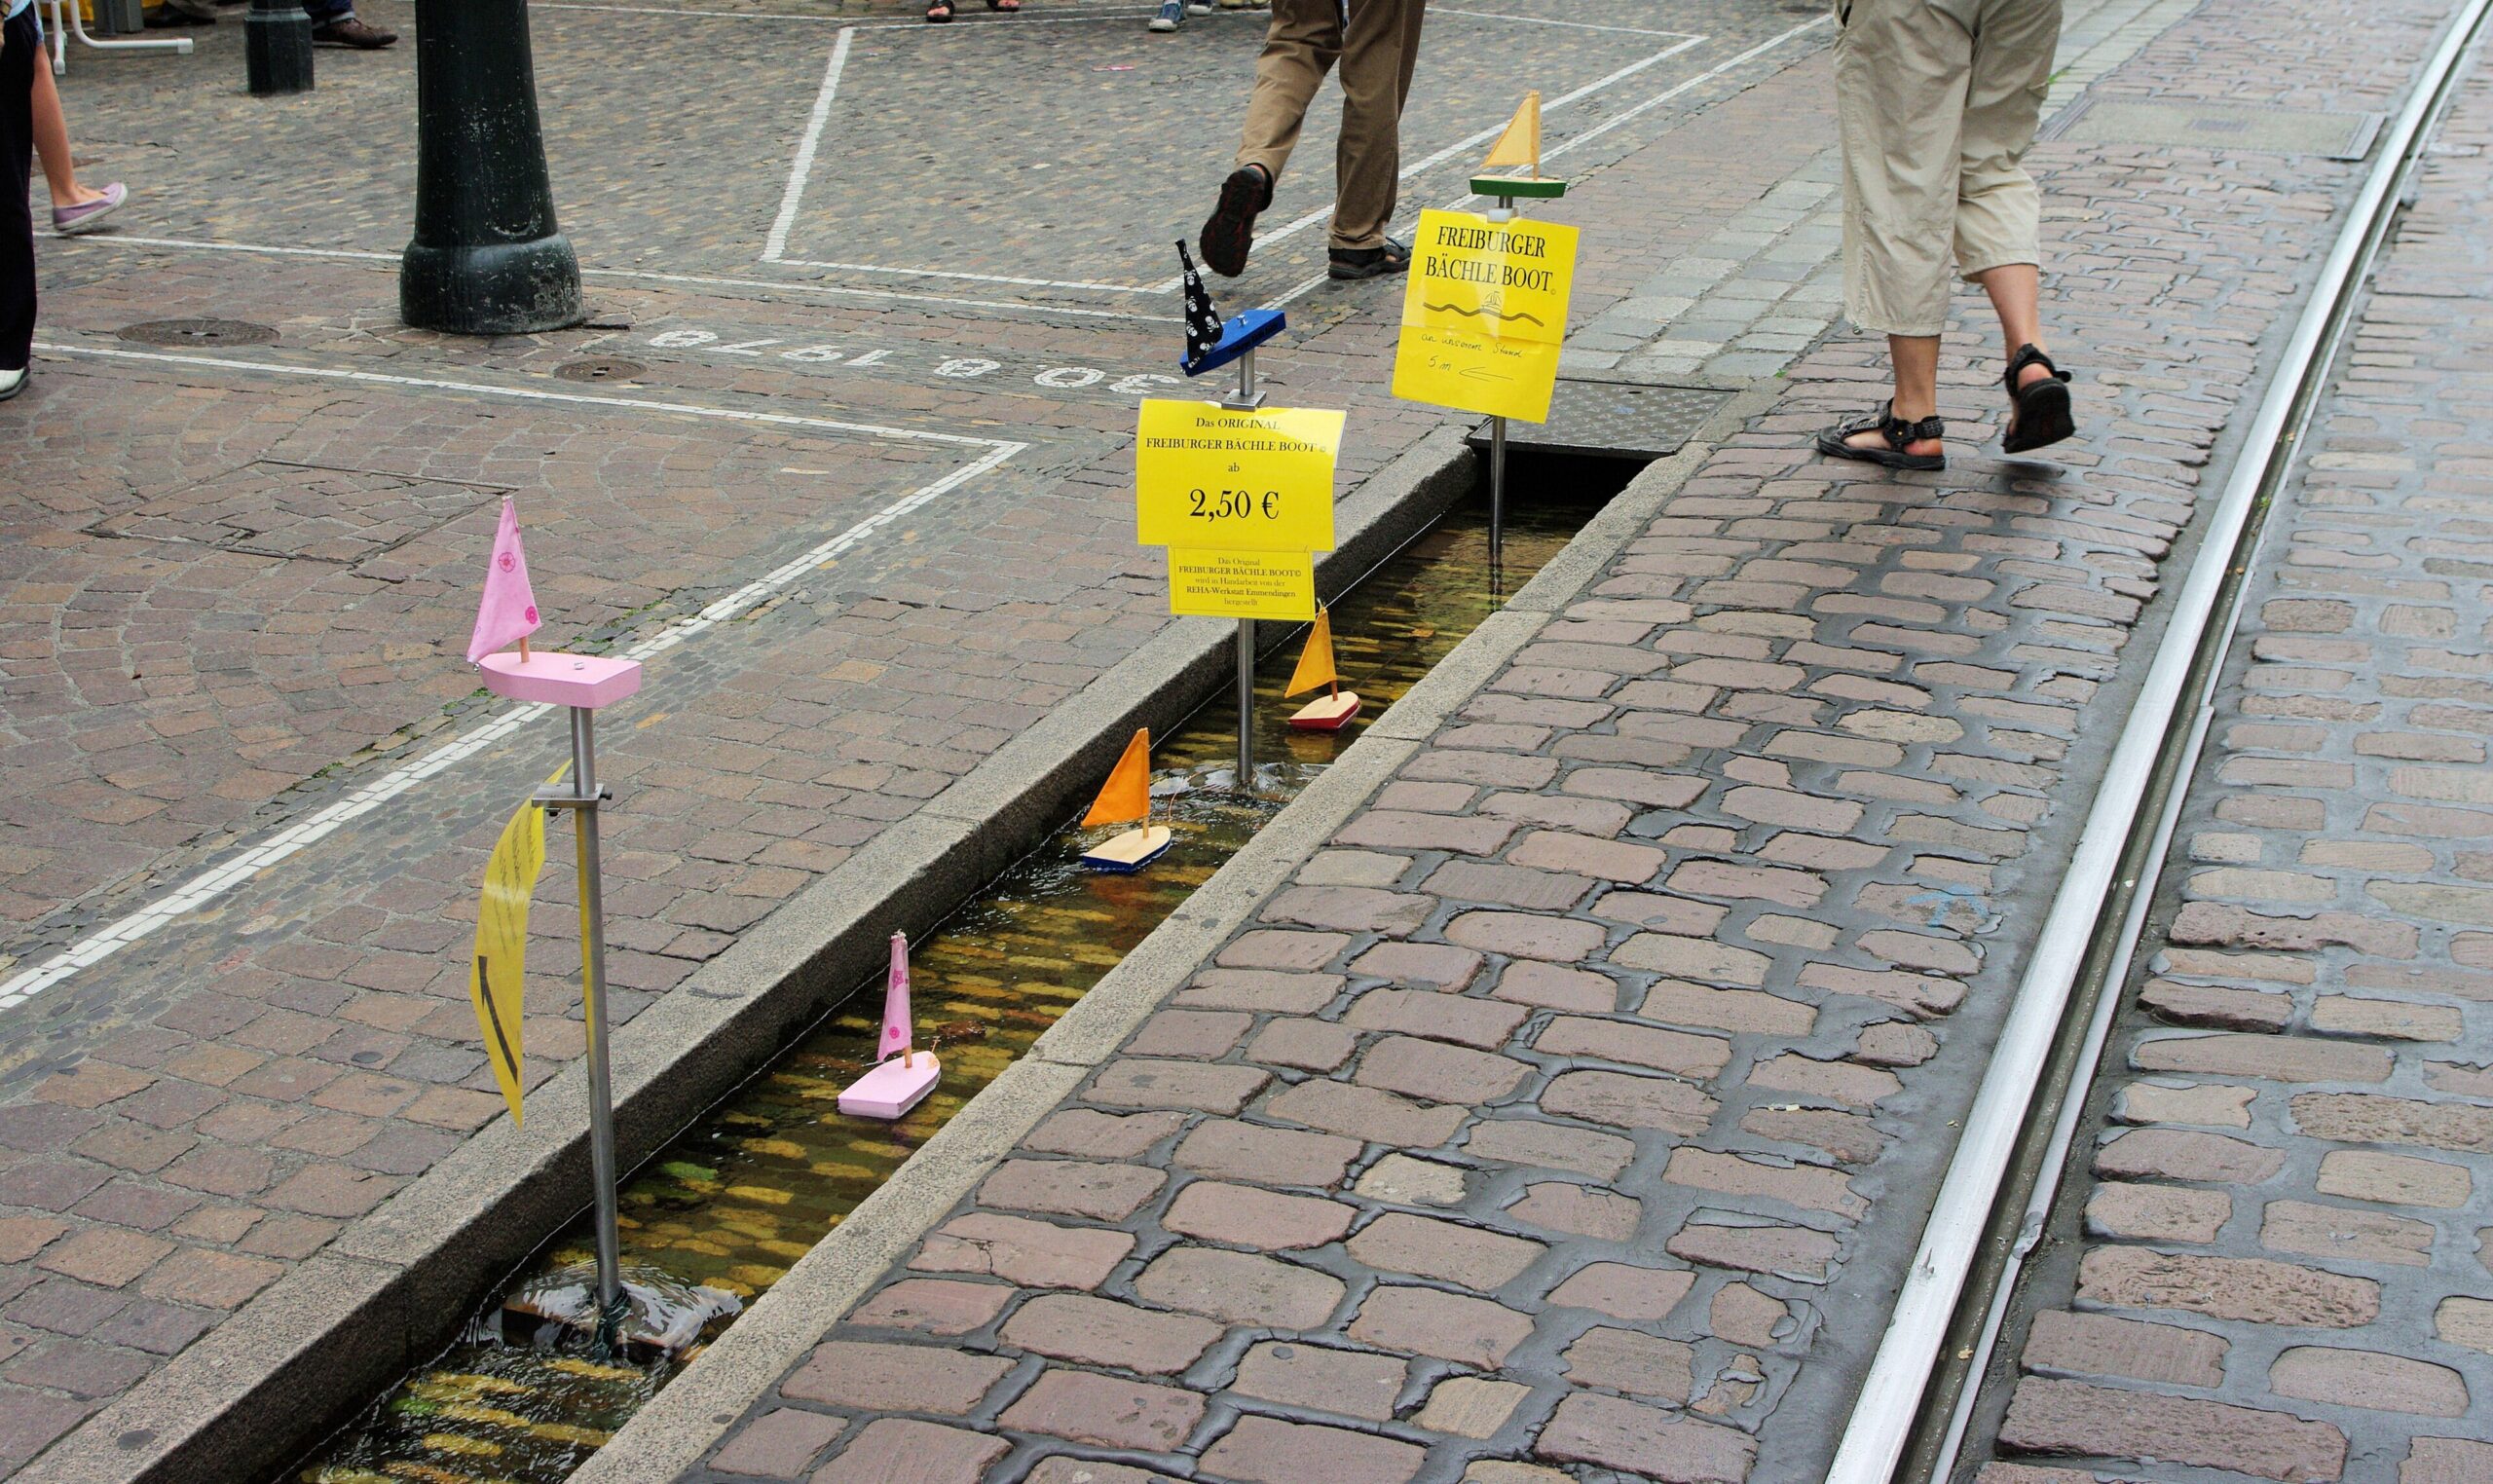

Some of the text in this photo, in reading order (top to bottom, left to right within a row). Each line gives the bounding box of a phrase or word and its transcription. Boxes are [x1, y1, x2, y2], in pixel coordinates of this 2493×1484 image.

[1436, 225, 1545, 258] FREIBURGER
[1425, 253, 1498, 284] BÄCHLE
[1428, 354, 1451, 371] 5 m
[1196, 417, 1281, 430] Das ORIGINAL
[1146, 437, 1222, 450] FREIBURGER
[1225, 437, 1276, 451] BÄCHLE
[1227, 463, 1240, 472] ab
[1189, 488, 1280, 522] 2,50 €
[1232, 557, 1260, 567] Original
[1178, 565, 1231, 575] FREIBURGER
[1233, 566, 1268, 576] BÄCHLE
